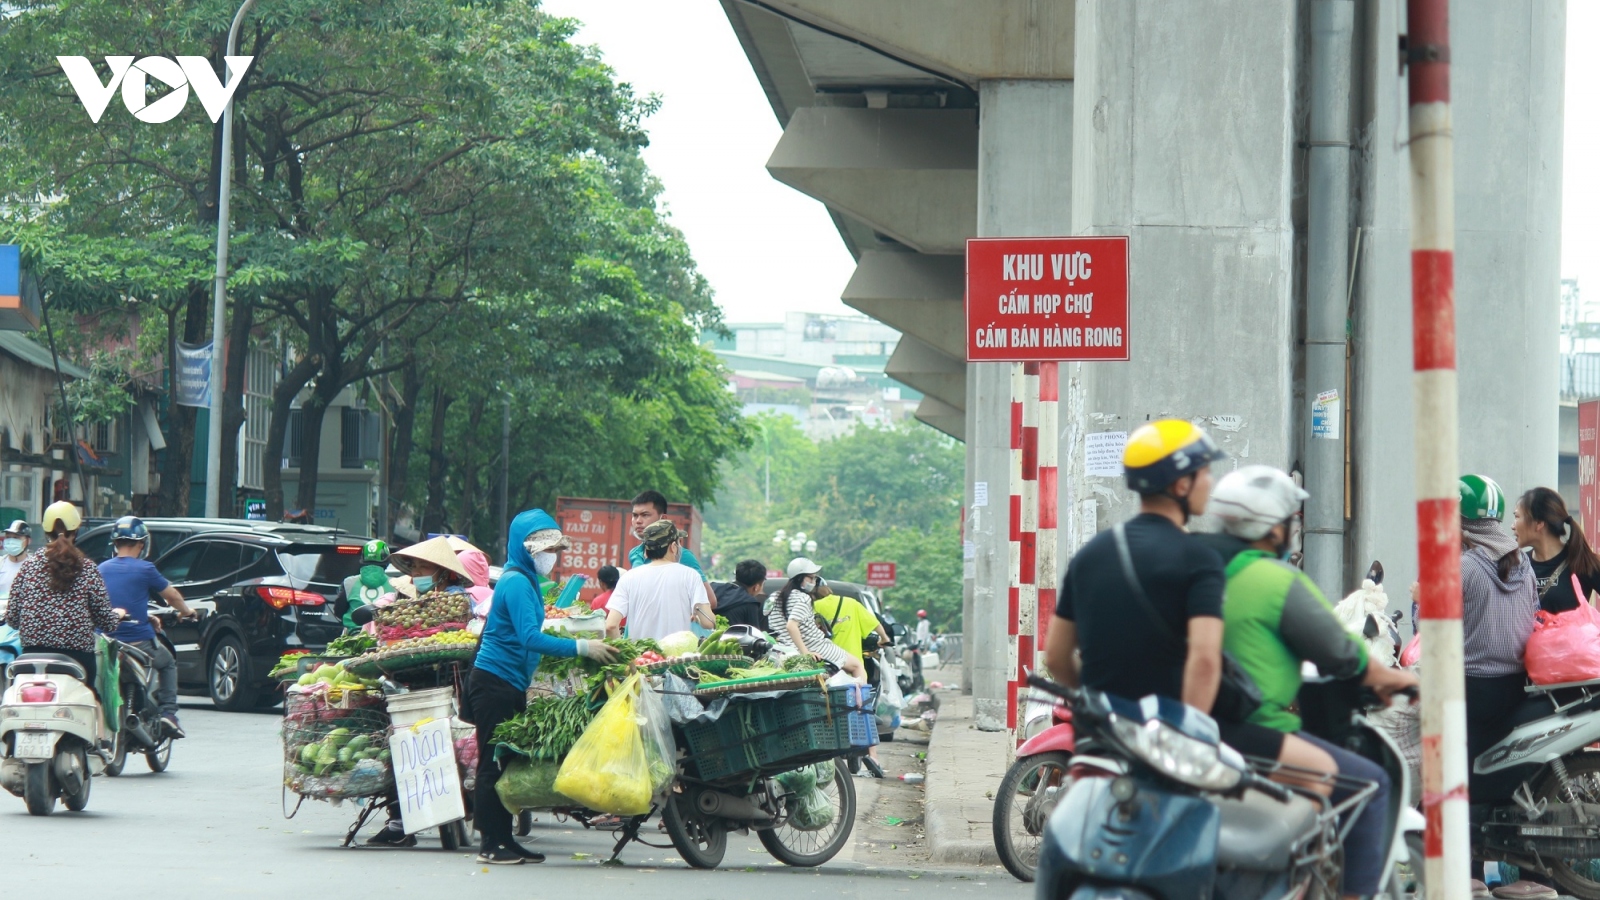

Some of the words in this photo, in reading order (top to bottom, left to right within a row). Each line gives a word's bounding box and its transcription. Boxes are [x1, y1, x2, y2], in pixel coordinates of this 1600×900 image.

[1003, 254, 1044, 281] KHU
[1051, 251, 1092, 287] VỰC
[998, 287, 1030, 315] CẤM
[1034, 294, 1062, 319] HỌP
[1064, 292, 1094, 319] CHỢ
[975, 322, 1007, 348] CẤM
[1011, 324, 1040, 348] BÁN
[1043, 323, 1082, 348] HÀNG
[1085, 327, 1122, 347] RONG
[566, 522, 589, 533] TAXI
[591, 521, 606, 535] TẢI
